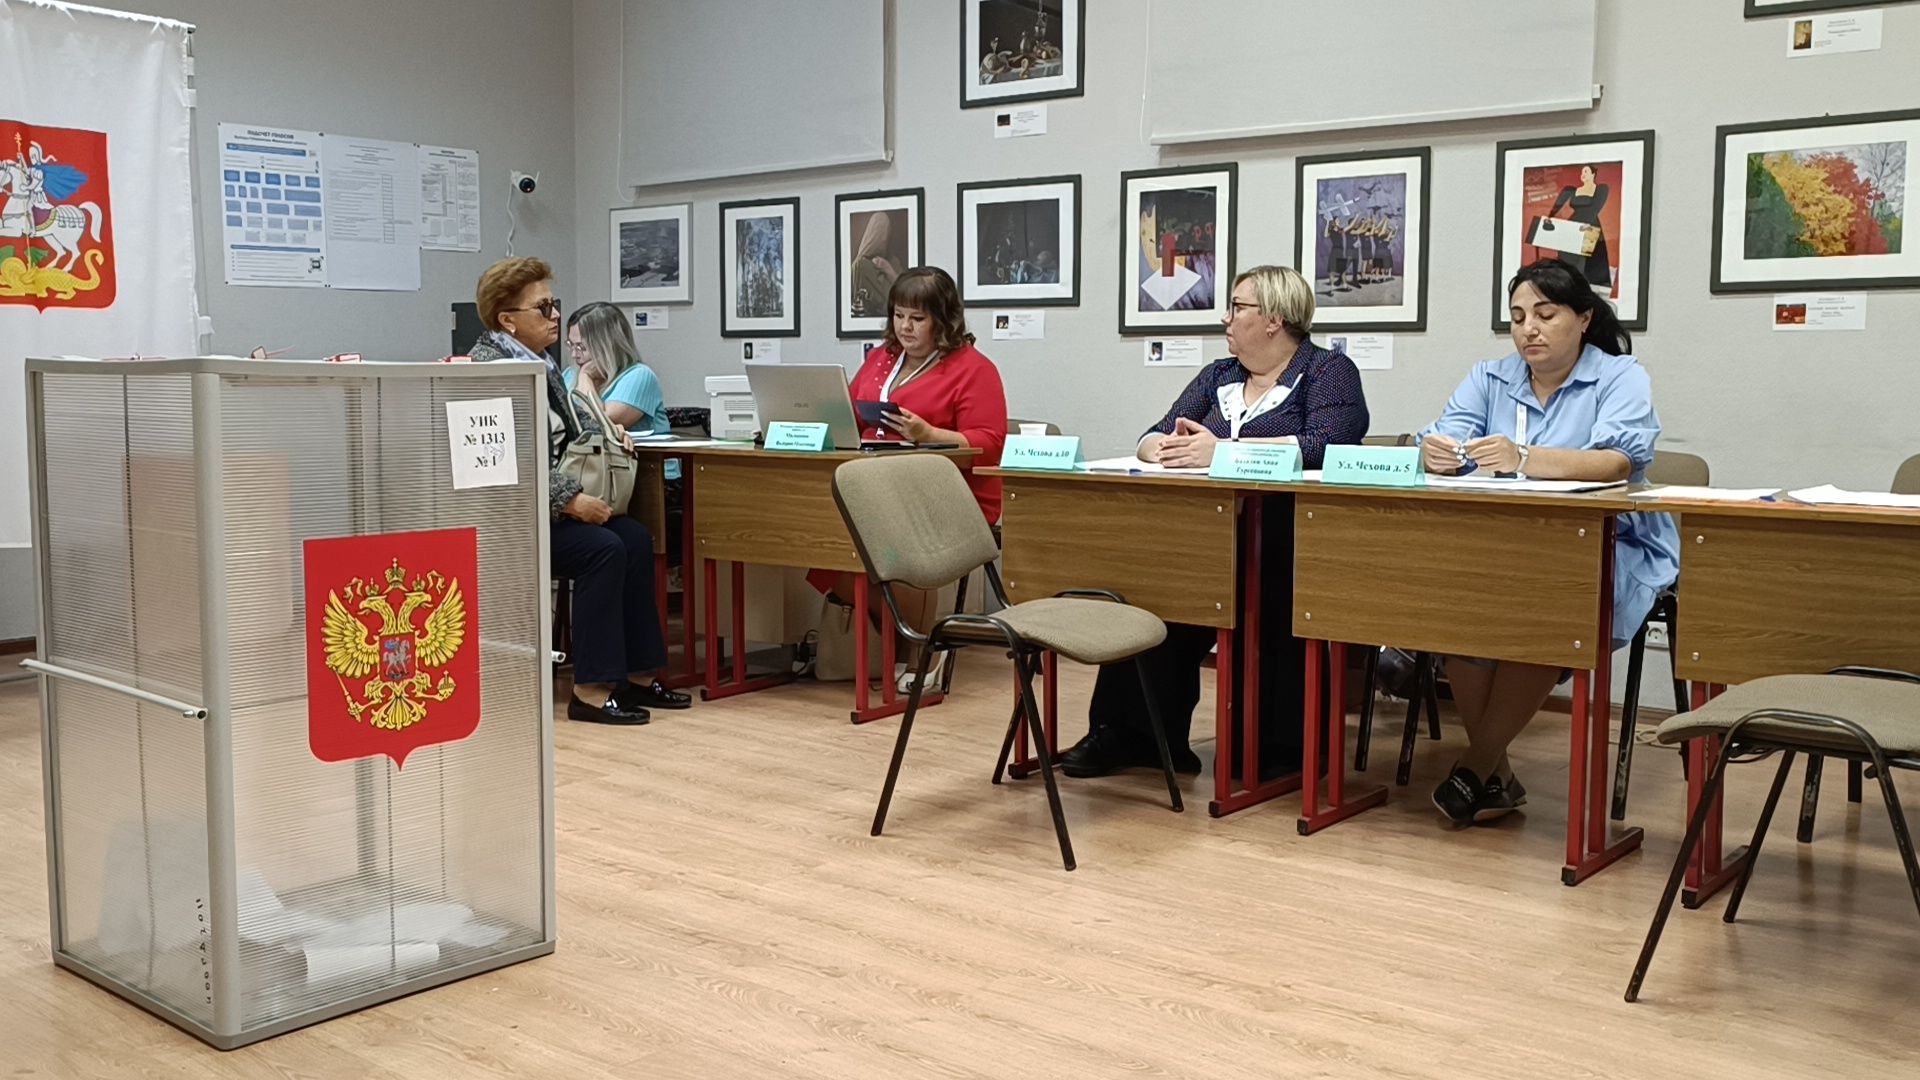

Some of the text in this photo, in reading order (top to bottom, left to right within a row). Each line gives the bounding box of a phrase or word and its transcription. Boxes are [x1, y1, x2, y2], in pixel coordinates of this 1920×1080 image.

[469, 414, 498, 428] УИК
[463, 431, 506, 447] № 1313
[475, 455, 497, 469] № 1
[1338, 460, 1353, 470] Ул.
[1356, 461, 1391, 472] Чехова
[1404, 463, 1411, 473] 5
